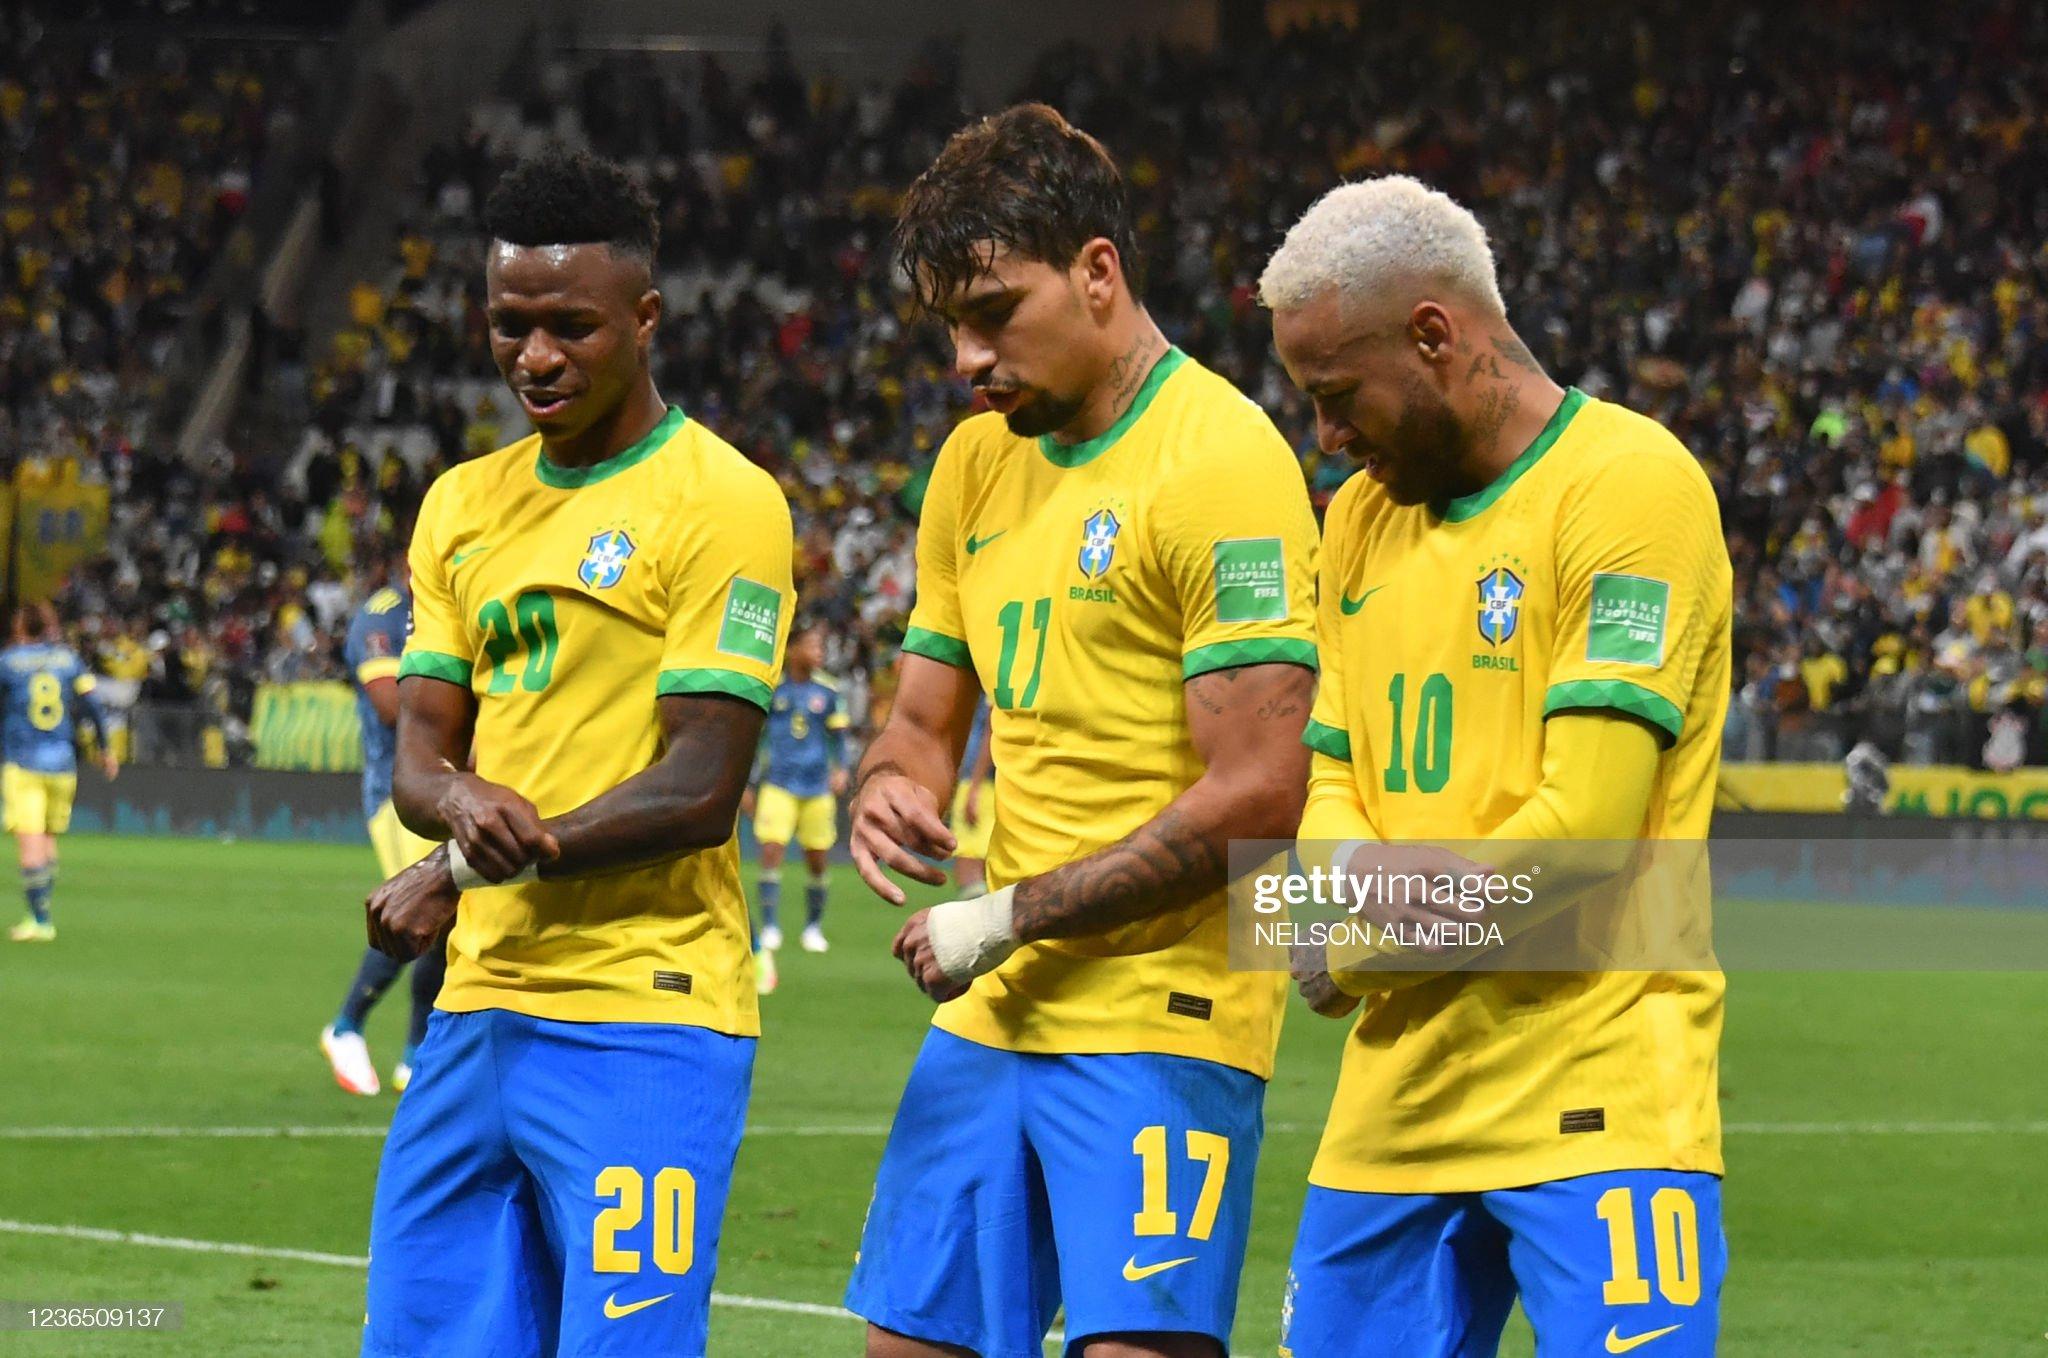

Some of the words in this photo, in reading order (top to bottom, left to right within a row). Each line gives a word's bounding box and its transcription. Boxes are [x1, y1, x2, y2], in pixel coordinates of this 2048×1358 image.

[1220, 561, 1279, 571] LIVING
[1221, 571, 1279, 580] FOOTBALL
[1069, 586, 1118, 603] BRASIL
[1254, 587, 1279, 598] FIFA
[1490, 600, 1508, 610] CBF
[1597, 598, 1660, 614] LIVING
[1597, 607, 1659, 624] FOOTBALL
[478, 591, 560, 694] 20
[1628, 629, 1657, 643] FIFA
[994, 597, 1052, 710] 17
[1472, 655, 1519, 671] BRASIL
[27, 672, 64, 732] 8
[1384, 673, 1453, 794] 10
[1133, 1125, 1230, 1241] 17
[593, 1166, 696, 1275] 20
[1596, 1187, 1700, 1306] 10
